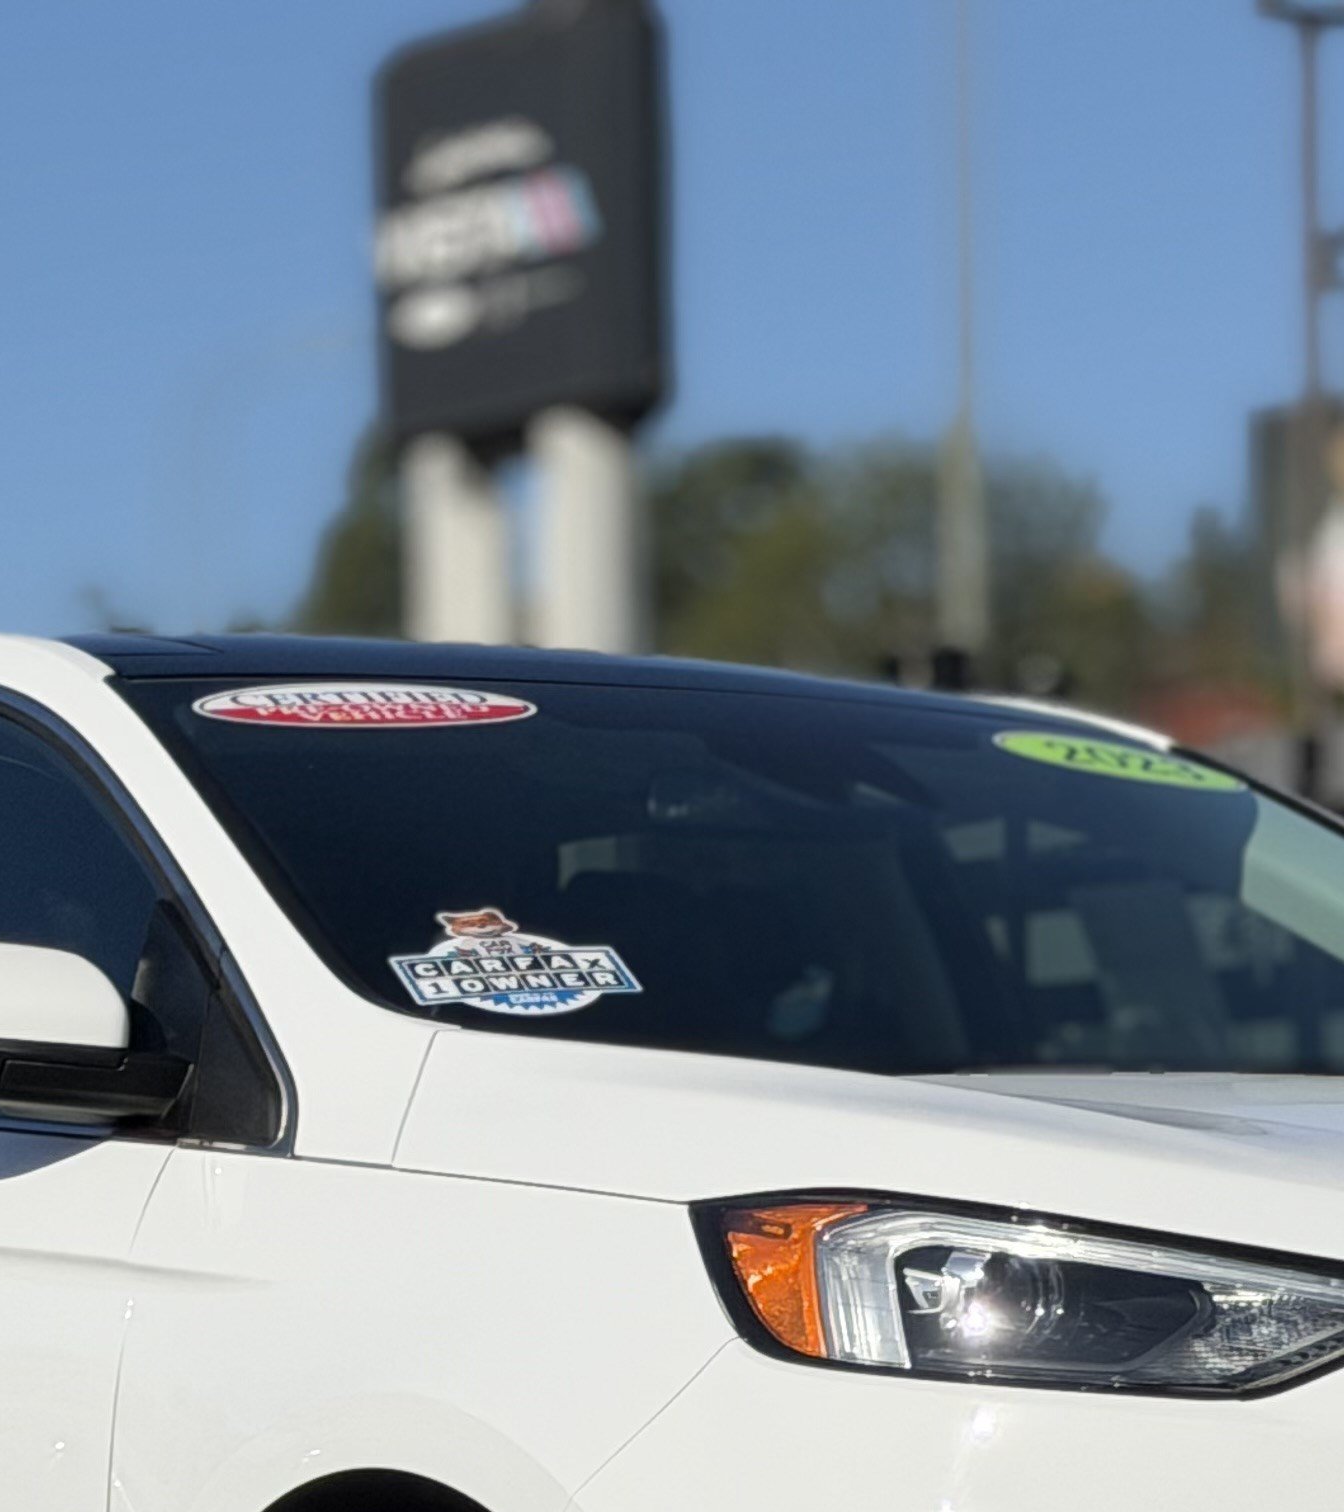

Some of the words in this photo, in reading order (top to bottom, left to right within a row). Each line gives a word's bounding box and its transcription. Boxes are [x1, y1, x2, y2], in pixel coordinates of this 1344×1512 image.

[413, 955, 606, 977] CARFAX
[427, 981, 450, 995] 1
[460, 972, 618, 993] OWNER
